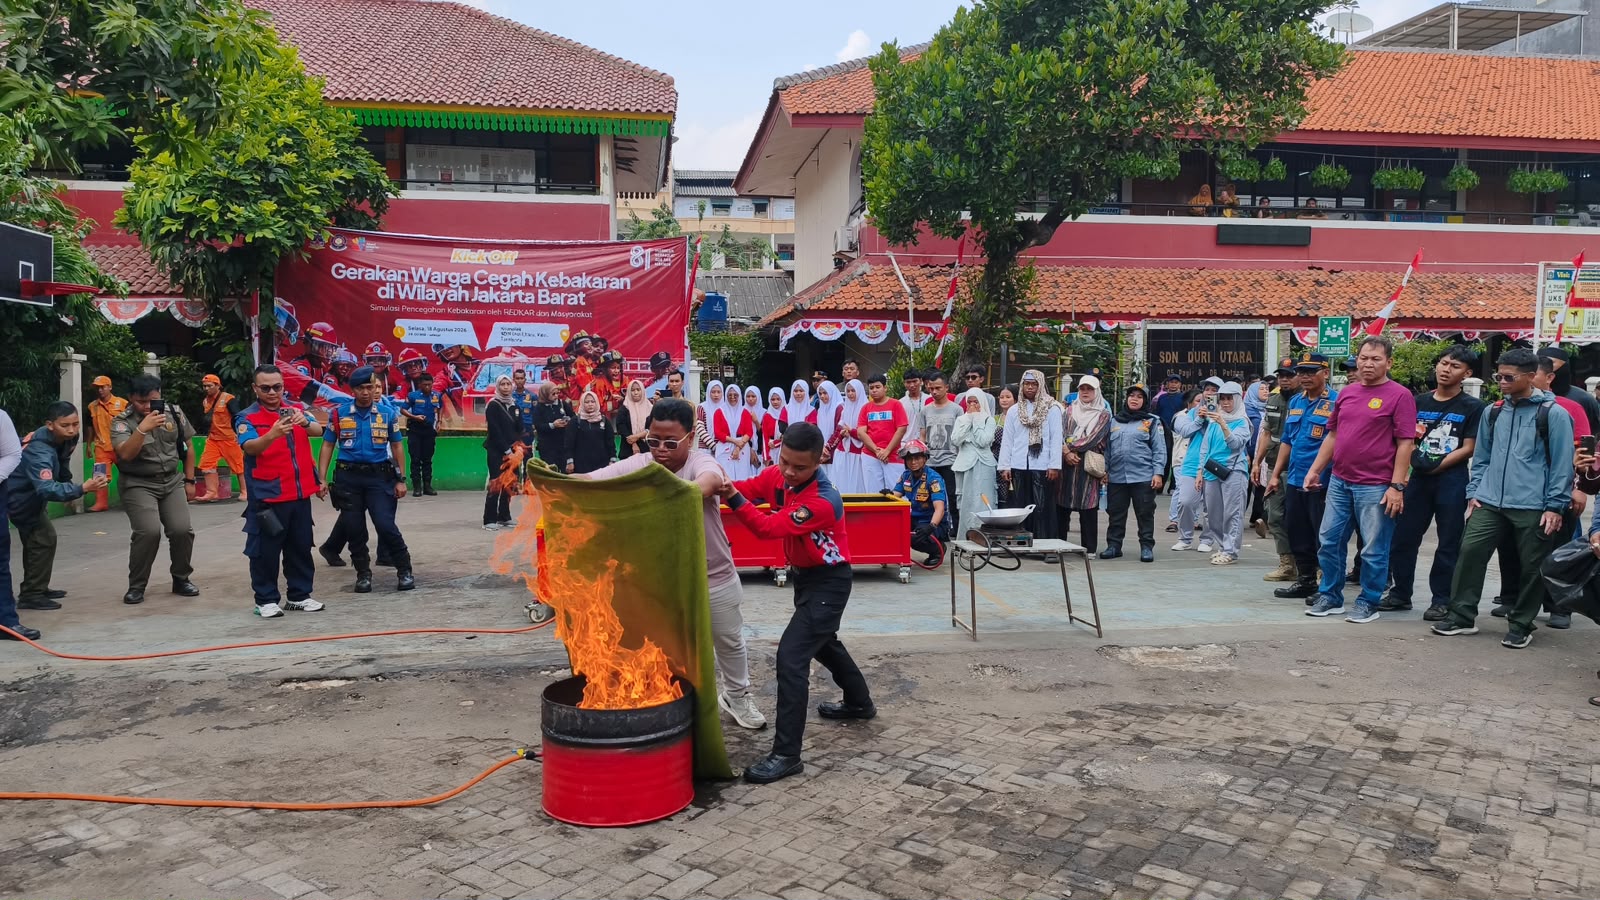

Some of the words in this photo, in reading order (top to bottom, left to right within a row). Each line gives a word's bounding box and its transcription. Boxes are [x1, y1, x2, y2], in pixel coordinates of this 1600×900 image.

[450, 248, 487, 264] Kick
[489, 249, 519, 265] Off
[630, 245, 653, 271] 81
[331, 263, 408, 282] Gerakan
[411, 267, 471, 288] Warga
[473, 269, 534, 290] Cegah
[535, 271, 631, 289] Kebakaran
[377, 283, 394, 299] di
[396, 284, 469, 305] Wilayah
[472, 286, 535, 304] Jakarta
[538, 289, 586, 305] Barat
[370, 304, 400, 312] Simulasi
[401, 305, 446, 315] Pencegahan
[447, 306, 486, 315] Kebakaran
[503, 308, 535, 316] REDKAR
[551, 310, 593, 318] Masyarakat
[1159, 351, 1179, 363] SDN
[1188, 351, 1211, 363] DURI
[1220, 351, 1253, 363] UTARA
[1178, 368, 1192, 378] Pagi
[1209, 368, 1217, 377] 06
